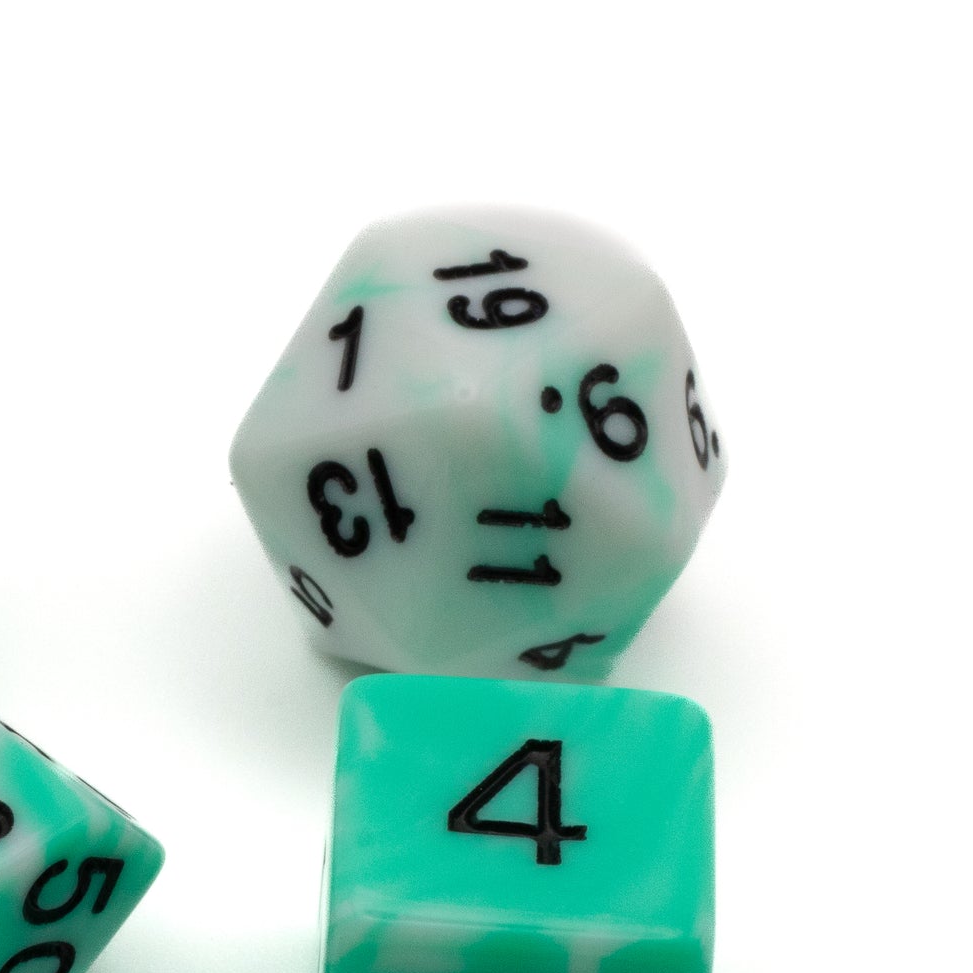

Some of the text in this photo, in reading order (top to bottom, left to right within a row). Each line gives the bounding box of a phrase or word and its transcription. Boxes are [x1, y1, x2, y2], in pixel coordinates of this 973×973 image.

[432, 248, 551, 330] 19
[328, 304, 365, 393] 1
[306, 447, 417, 560] 13
[466, 497, 573, 589] 11
[446, 738, 588, 866] 4
